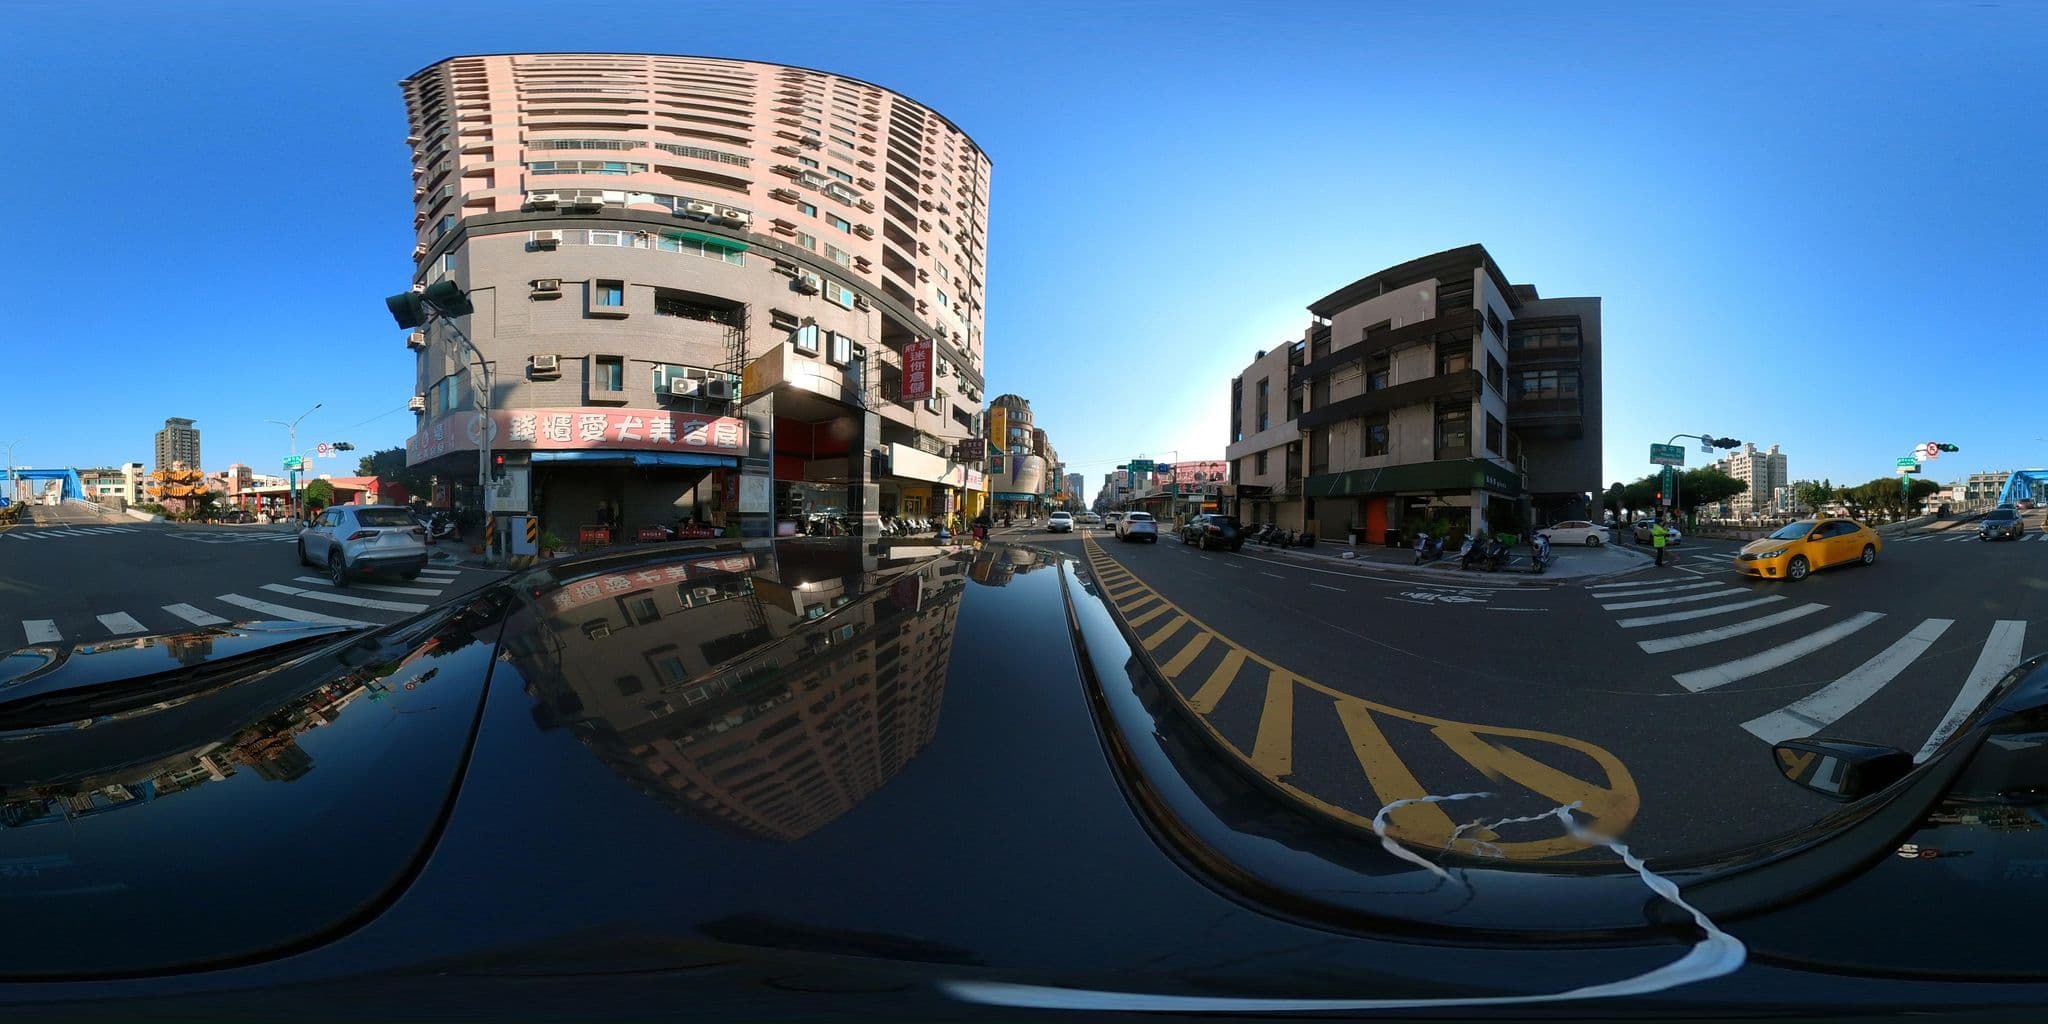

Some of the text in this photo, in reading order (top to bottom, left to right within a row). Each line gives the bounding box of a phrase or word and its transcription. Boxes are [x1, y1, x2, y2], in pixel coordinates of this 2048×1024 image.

[910, 351, 926, 393] 迷你倉儲
[509, 413, 738, 449] 錢櫃愛犬美容屋
